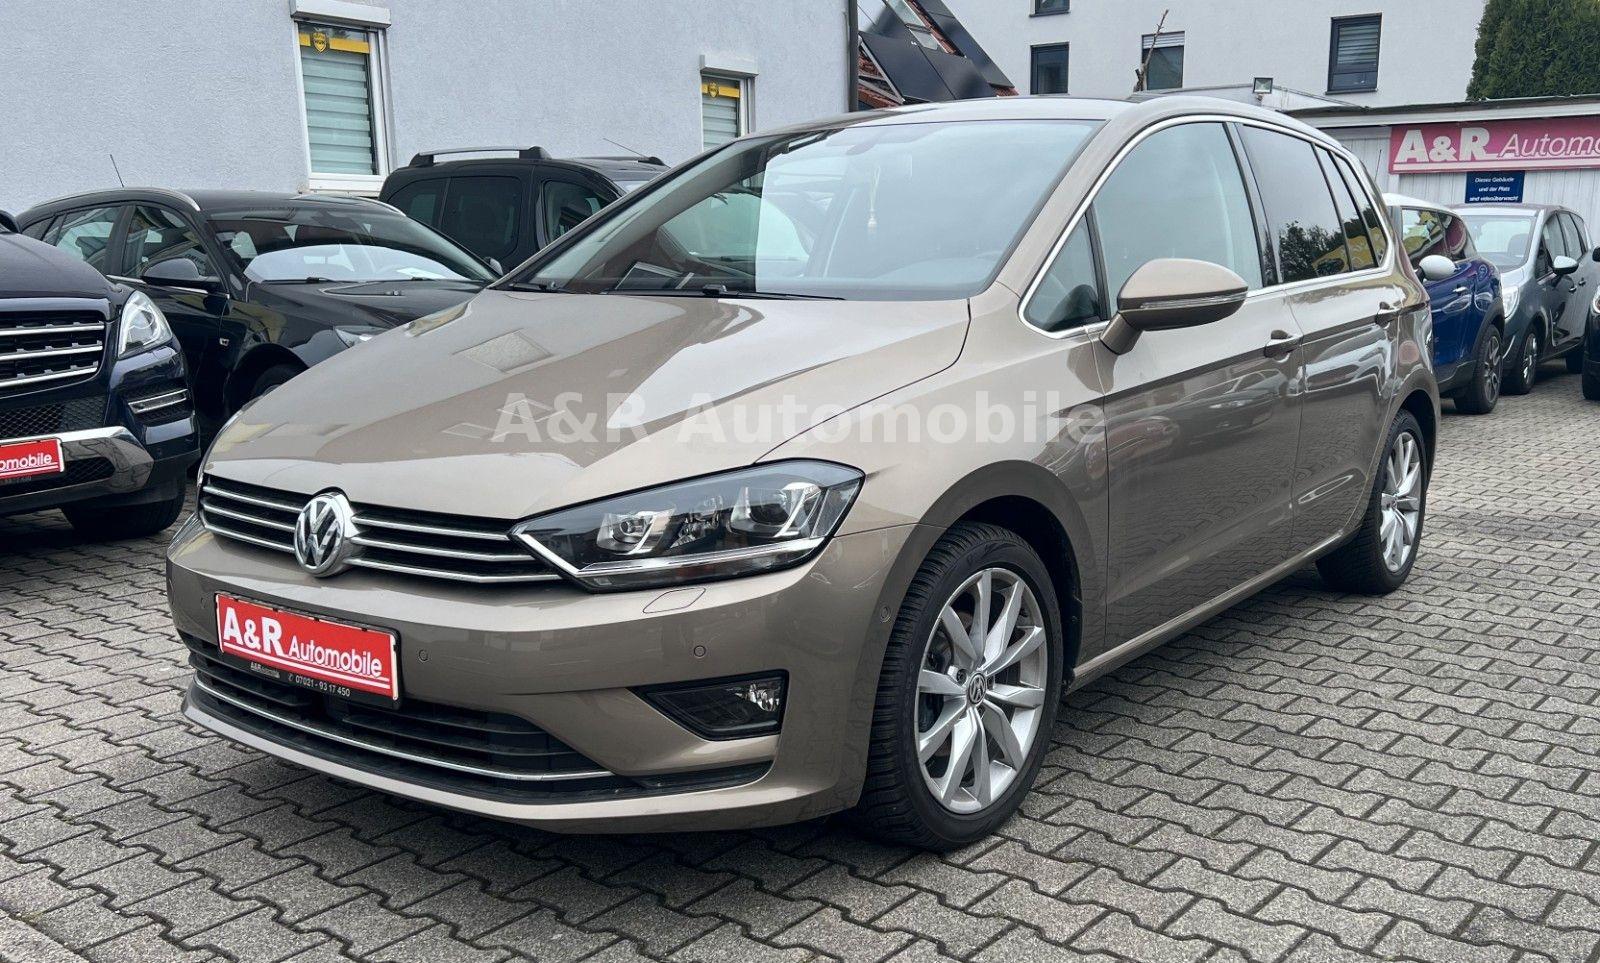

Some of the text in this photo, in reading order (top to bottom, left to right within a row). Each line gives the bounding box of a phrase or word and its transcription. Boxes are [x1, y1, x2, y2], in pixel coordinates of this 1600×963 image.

[1394, 127, 1490, 163] A&R
[223, 606, 382, 678] A&R Automobile
[295, 675, 314, 687] 07021
[319, 681, 328, 691] 93
[337, 687, 351, 697] 450
